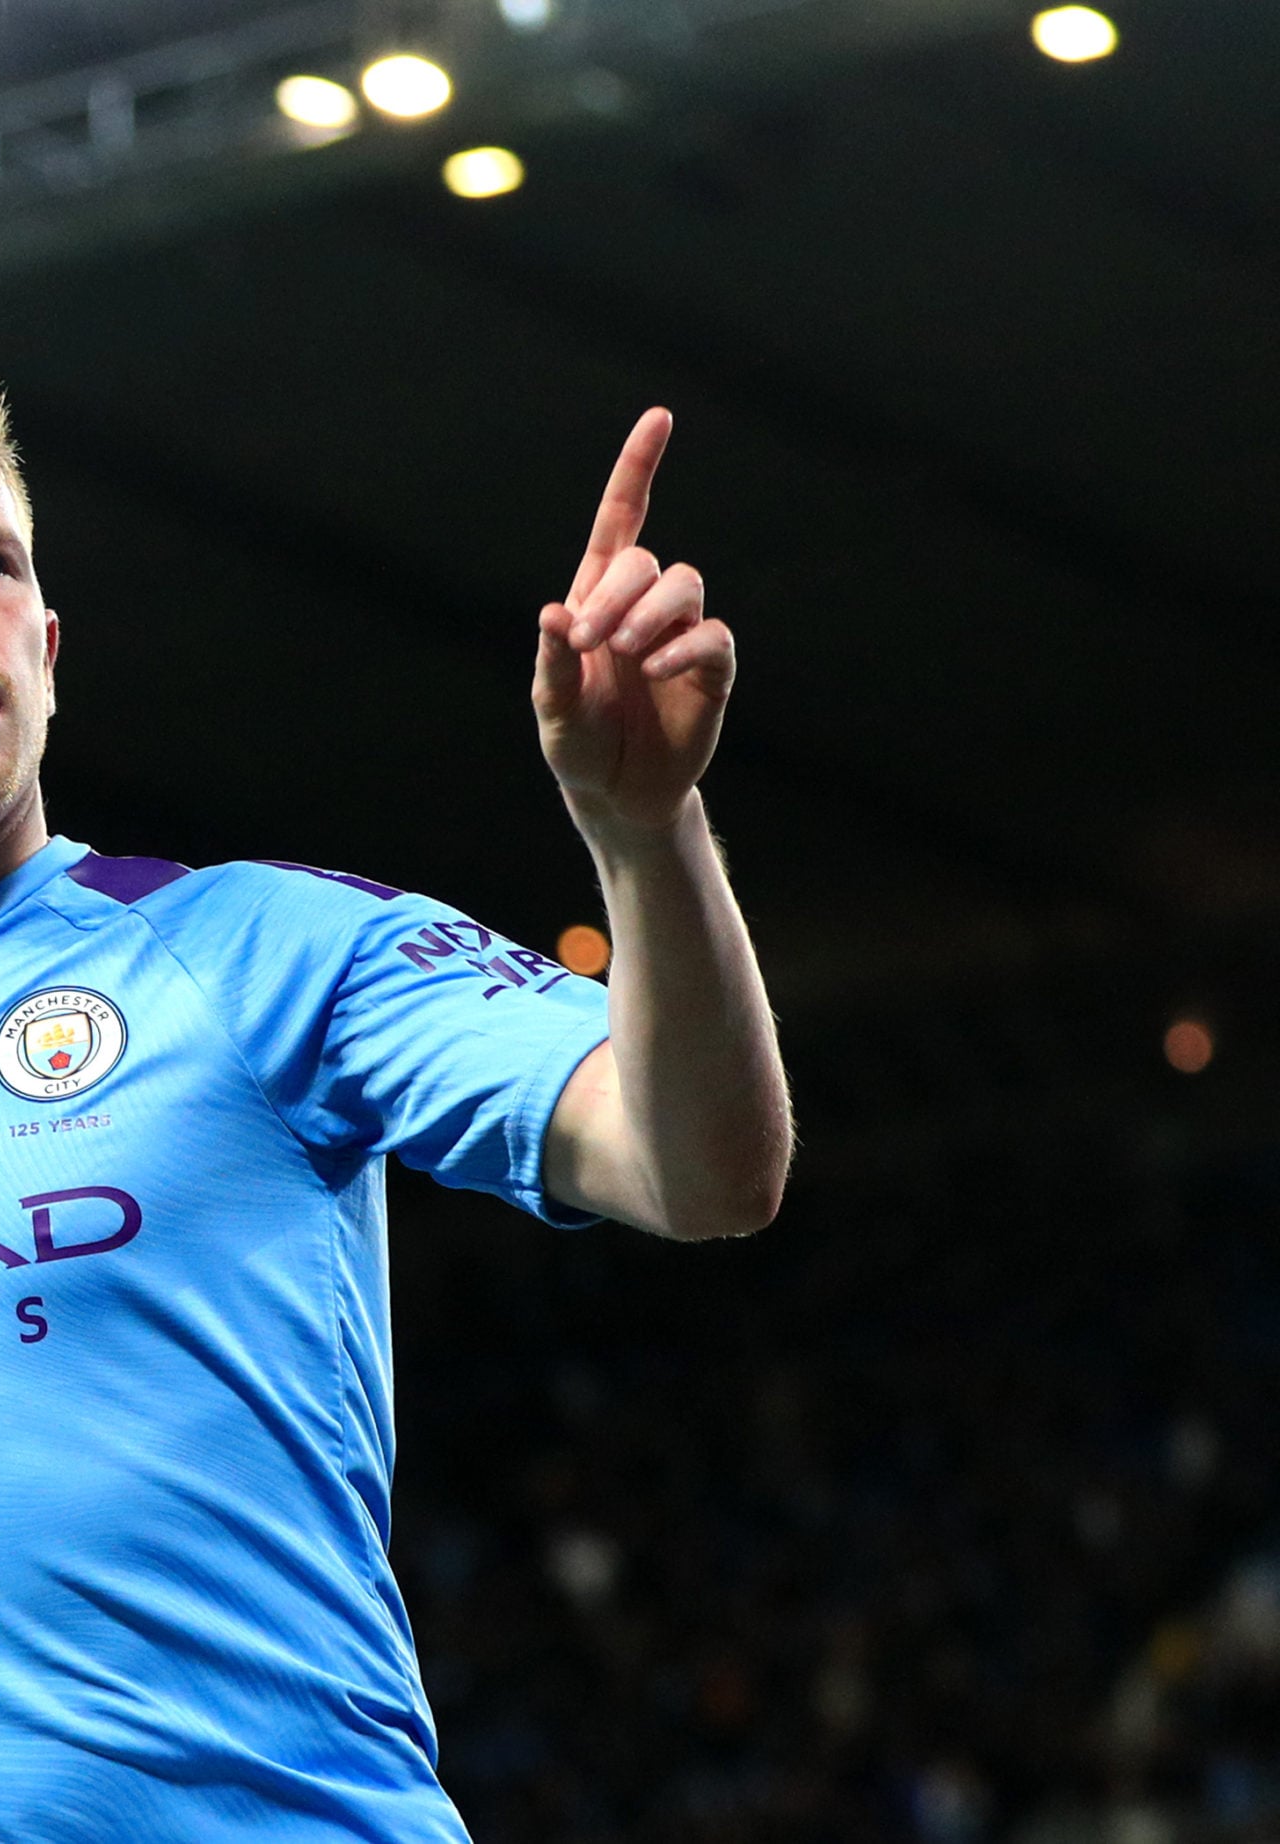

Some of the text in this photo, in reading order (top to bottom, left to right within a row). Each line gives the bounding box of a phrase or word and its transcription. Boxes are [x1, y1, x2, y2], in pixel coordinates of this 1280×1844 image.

[396, 920, 493, 974] NEX
[4, 995, 110, 1040] MANCHESTER
[44, 1078, 82, 1094] CITY
[9, 1114, 111, 1138] 125 YEARS
